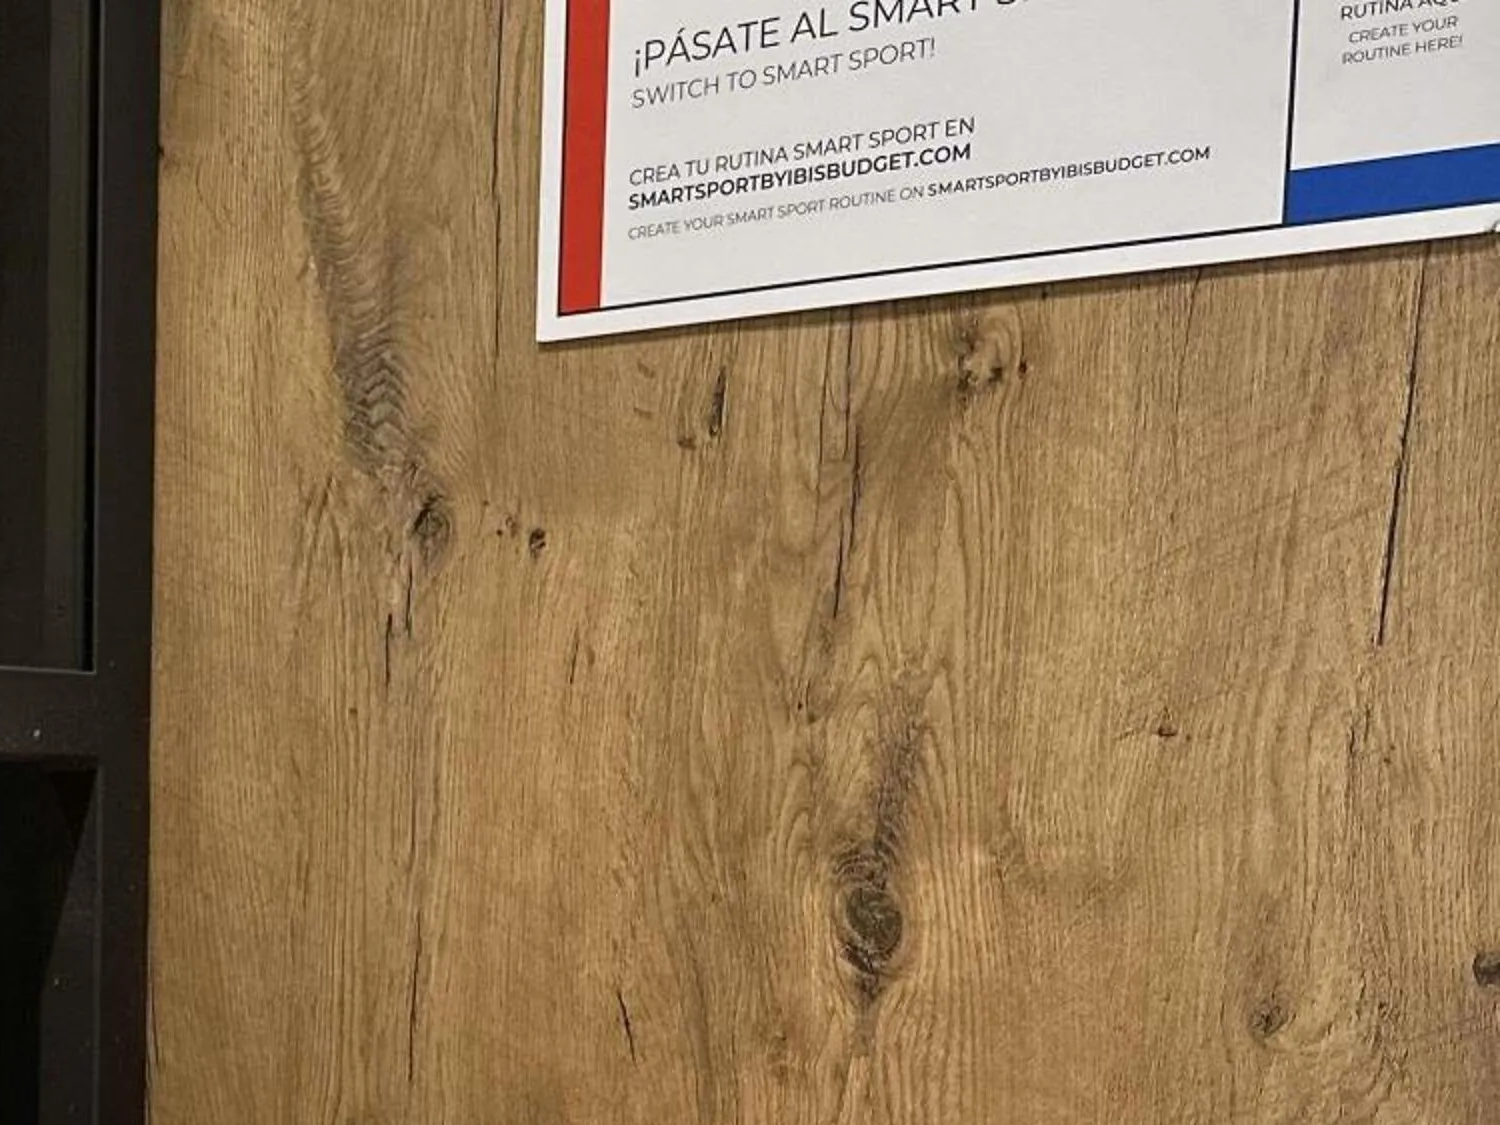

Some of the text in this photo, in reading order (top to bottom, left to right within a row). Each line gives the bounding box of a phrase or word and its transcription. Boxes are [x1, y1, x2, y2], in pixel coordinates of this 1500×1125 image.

[634, 17, 781, 78] ¡PÁSATE
[790, 8, 839, 43] AL
[1340, 0, 1413, 20] RUTINA
[1349, 15, 1459, 43] CREATE YOUR
[631, 37, 937, 109] SWITCH TO SMART SPORT!
[1341, 43, 1411, 64] ROUTINE
[628, 143, 972, 211] SMARTSPORTBYIBISBUDGET.COM
[629, 116, 976, 187] CREA TU RUTINA SMART SPORT EN
[628, 146, 1211, 240] CREATE YOUR SMART SPORT ROUTINE ON SMARTSPORTBYIBISBUDGET.COM
